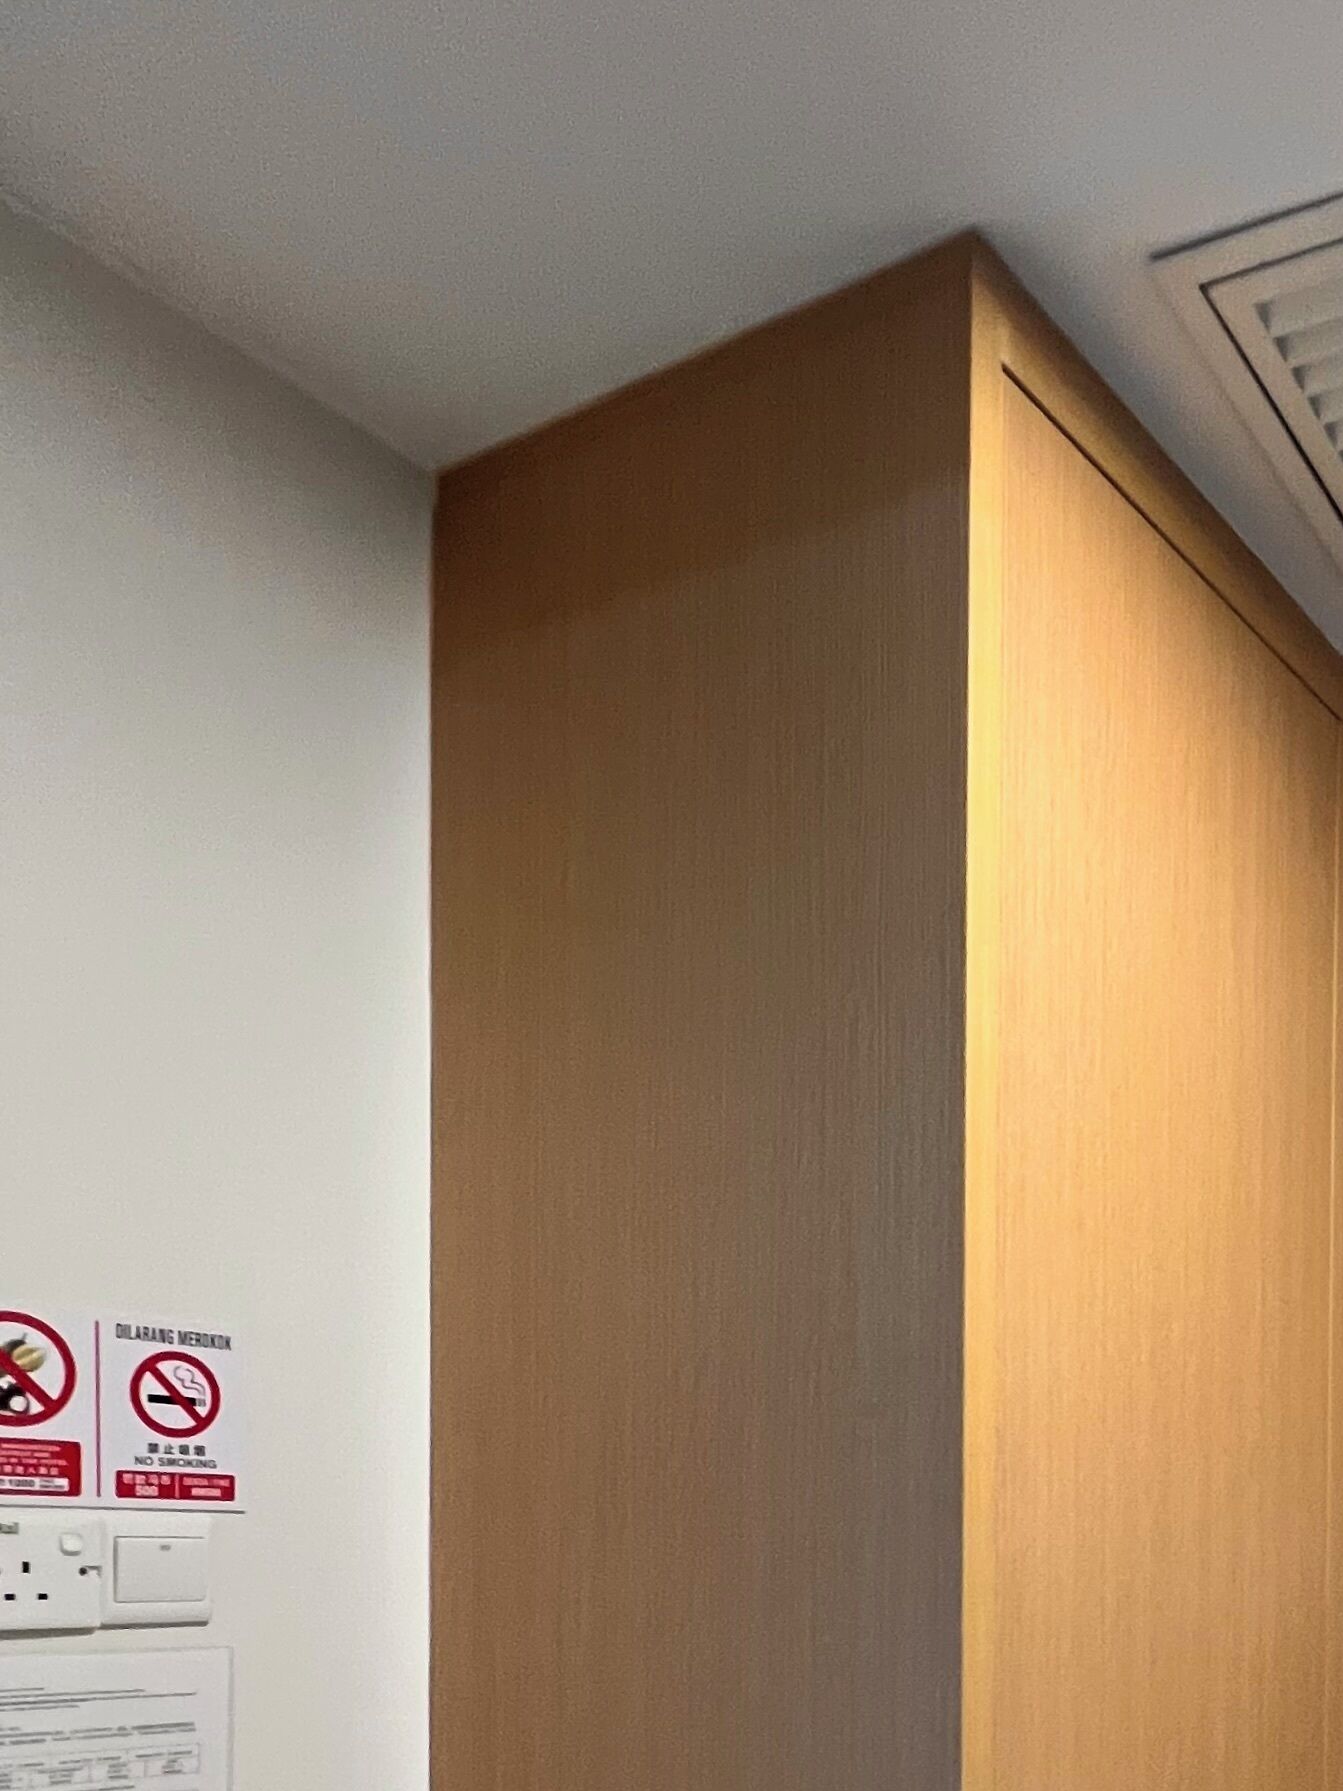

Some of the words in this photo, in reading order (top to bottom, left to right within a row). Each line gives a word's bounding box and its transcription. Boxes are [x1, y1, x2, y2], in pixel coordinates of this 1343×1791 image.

[115, 1322, 174, 1344] DILARANG
[177, 1330, 232, 1350] MEROKOK
[134, 1456, 154, 1466] NO
[158, 1457, 217, 1469] SMOKING
